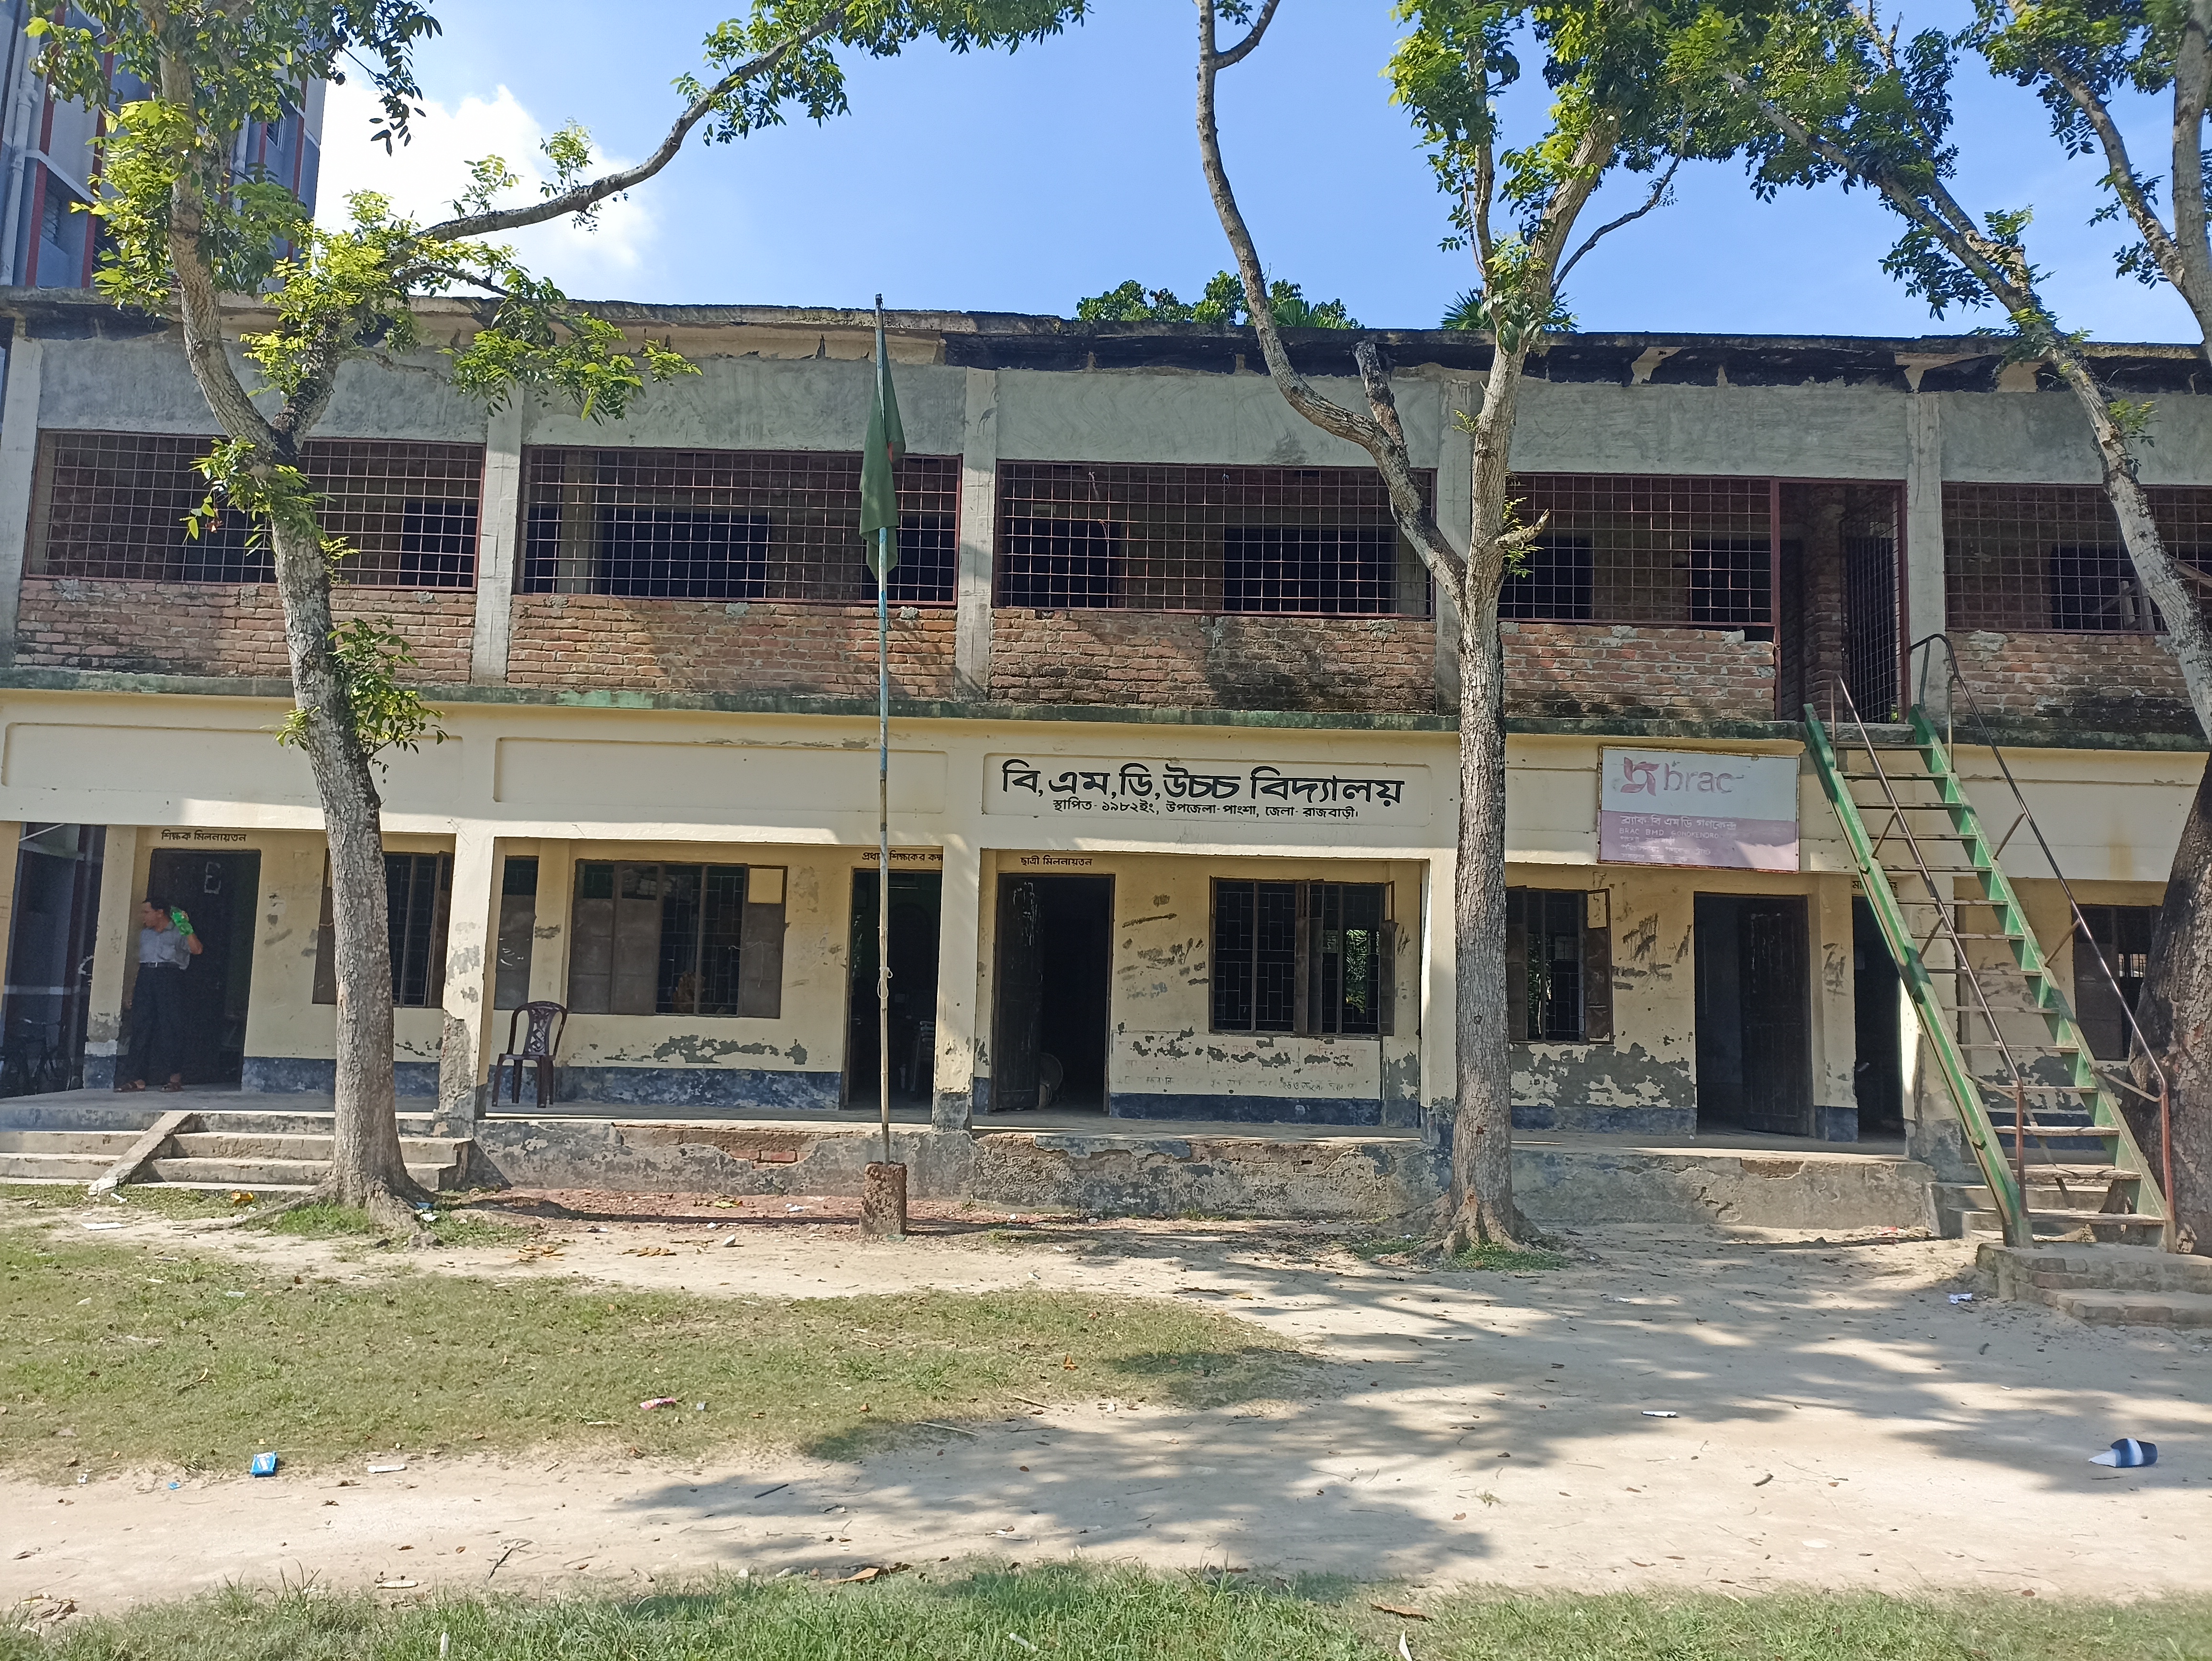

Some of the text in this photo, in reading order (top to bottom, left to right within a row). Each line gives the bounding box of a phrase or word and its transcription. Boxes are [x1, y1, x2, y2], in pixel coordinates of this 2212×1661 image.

[1250, 765, 1405, 807] বিদ্যালয়
[1663, 762, 1735, 794] brac
[194, 830, 247, 842] মিলনায়তন
[1020, 854, 1093, 866] ছাত্রী মিলনায়তন
